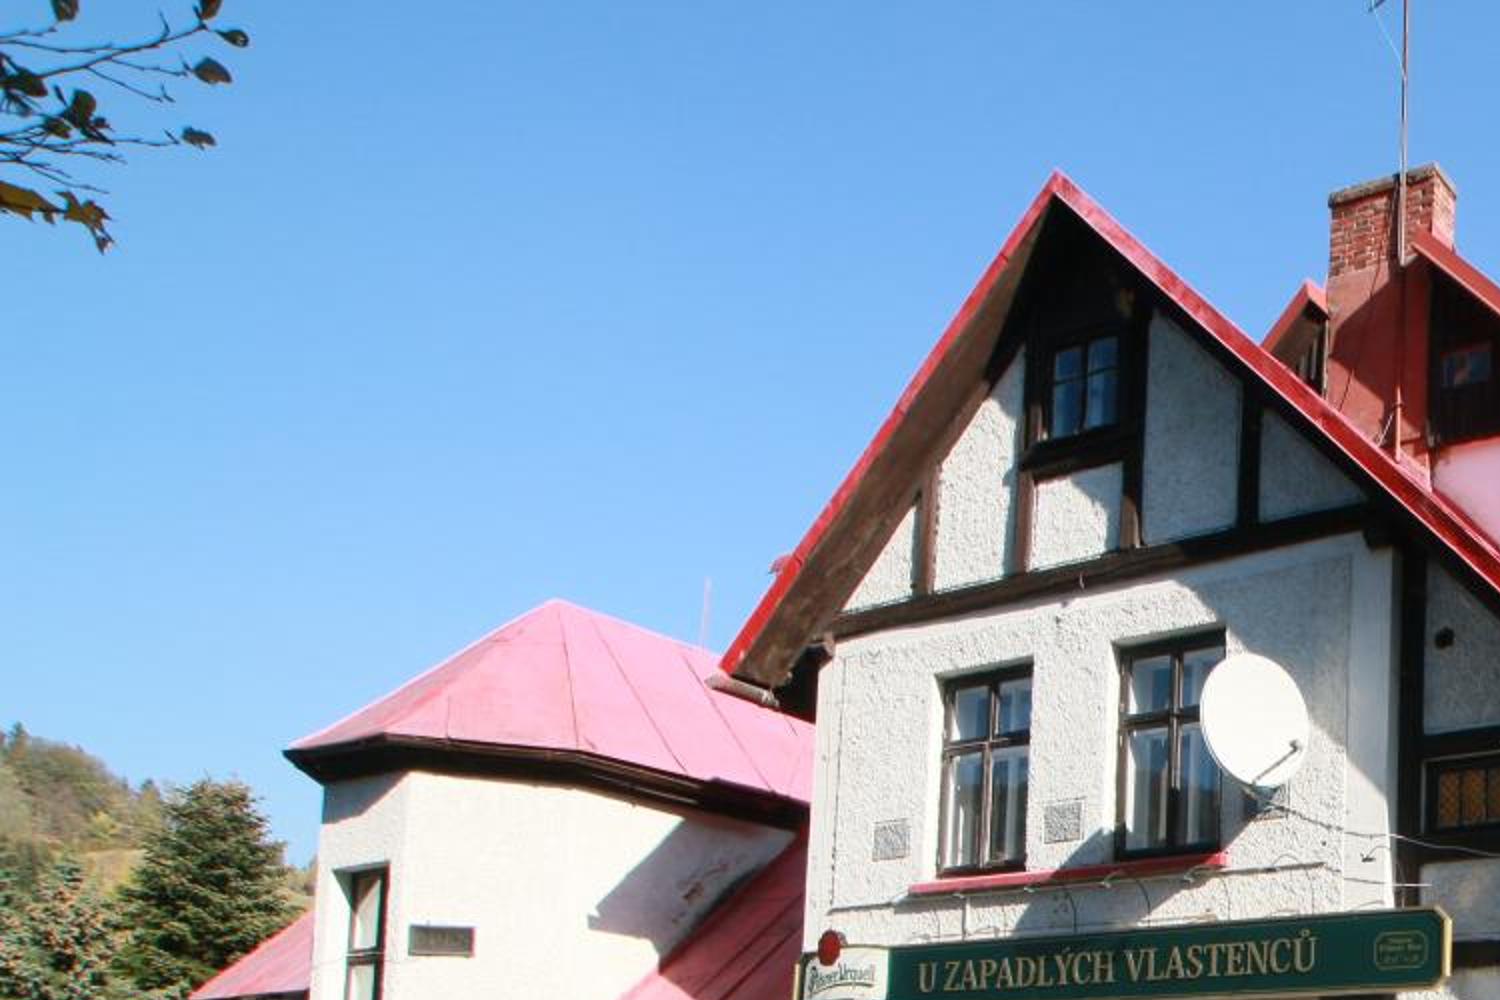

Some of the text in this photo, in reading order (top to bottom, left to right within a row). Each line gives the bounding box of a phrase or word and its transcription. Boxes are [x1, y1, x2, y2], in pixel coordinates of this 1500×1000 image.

[918, 929, 1319, 993] U ZAPADLÝCH VLASTENCŮ
